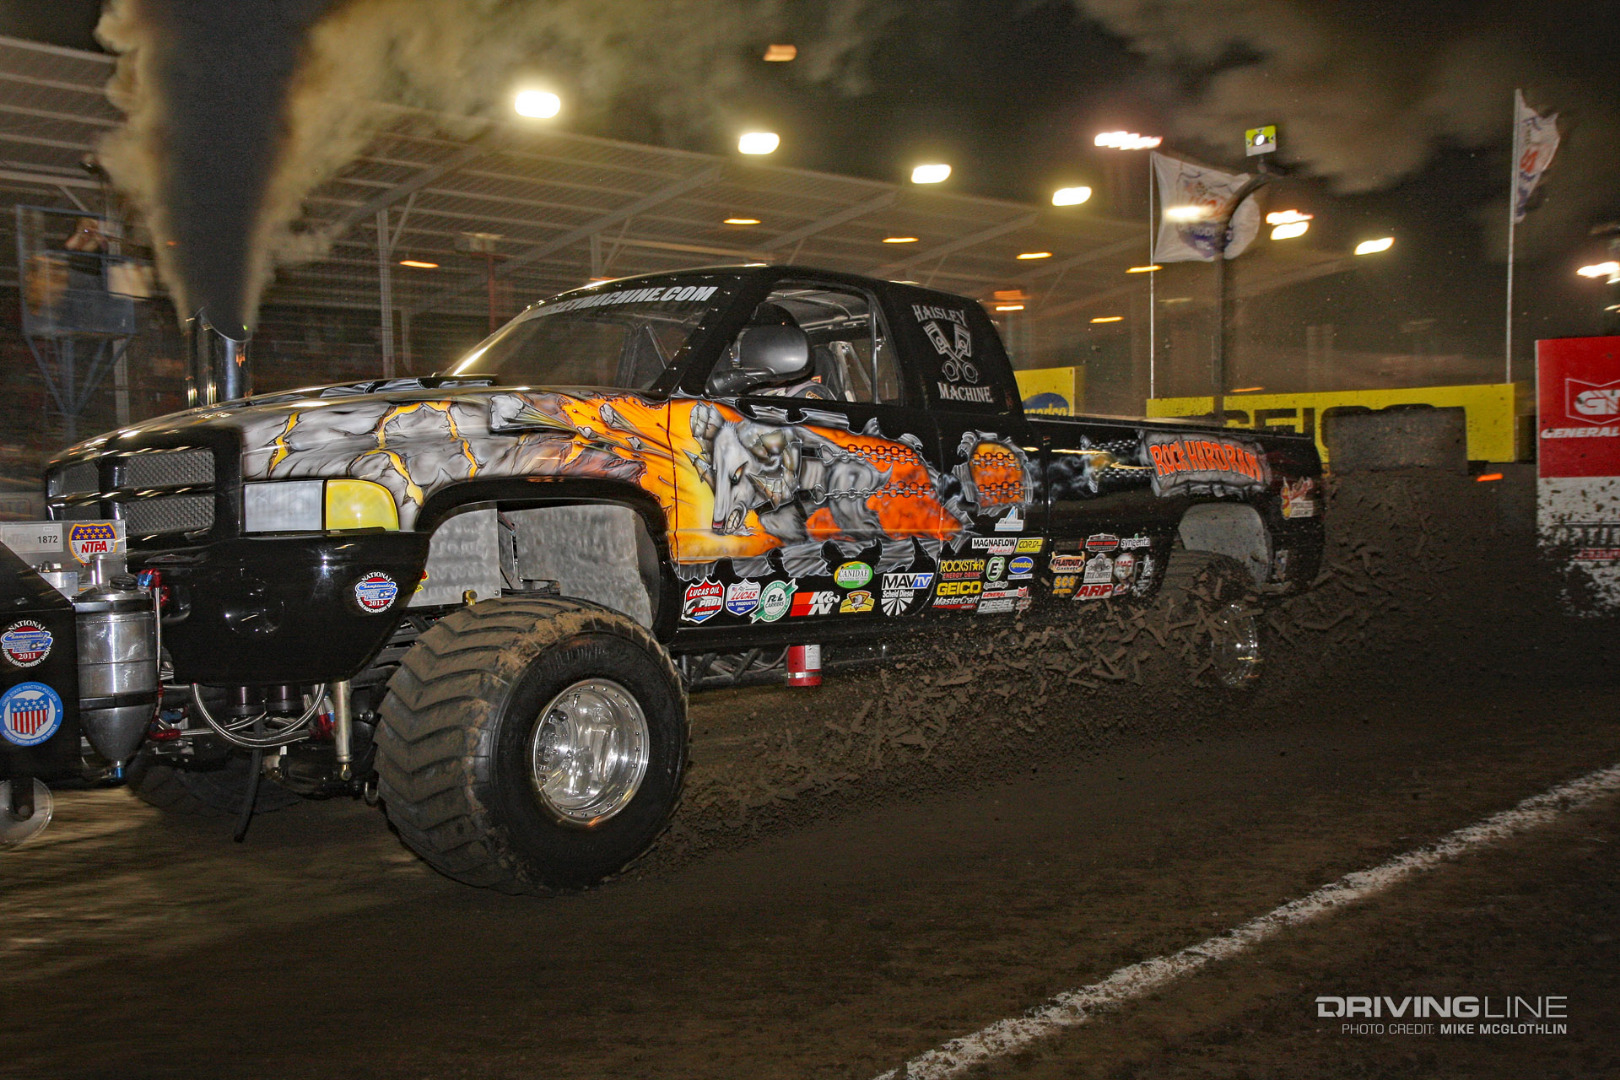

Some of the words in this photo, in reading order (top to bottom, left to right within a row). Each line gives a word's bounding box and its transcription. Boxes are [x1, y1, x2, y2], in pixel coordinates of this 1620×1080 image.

[912, 305, 968, 328] HAISLEY
[937, 382, 993, 403] MACHINE
[1541, 427, 1620, 439] GENERAL
[1150, 441, 1190, 477] ROCK
[1184, 441, 1229, 471] HARD
[1224, 444, 1261, 482] RAM
[37, 535, 58, 544] 1872
[974, 539, 1015, 547] MAGNAFLOW
[1121, 538, 1150, 549] syngenta
[81, 541, 107, 553] NTPA
[362, 571, 392, 582] NATIONAL
[839, 569, 868, 578] CANIDAE
[883, 575, 931, 589] MAVTV
[1054, 576, 1075, 587] SCS
[689, 588, 709, 597] LUCAS
[883, 590, 899, 598] Scheid
[900, 589, 914, 598] Diesel
[936, 581, 982, 596] GEICO
[1076, 585, 1112, 597] ARP
[731, 591, 758, 600] LUCAS
[933, 596, 979, 605] MasterCraft
[808, 591, 840, 615] K&N
[8, 620, 46, 633] NATIONAL
[18, 652, 36, 660] 2011
